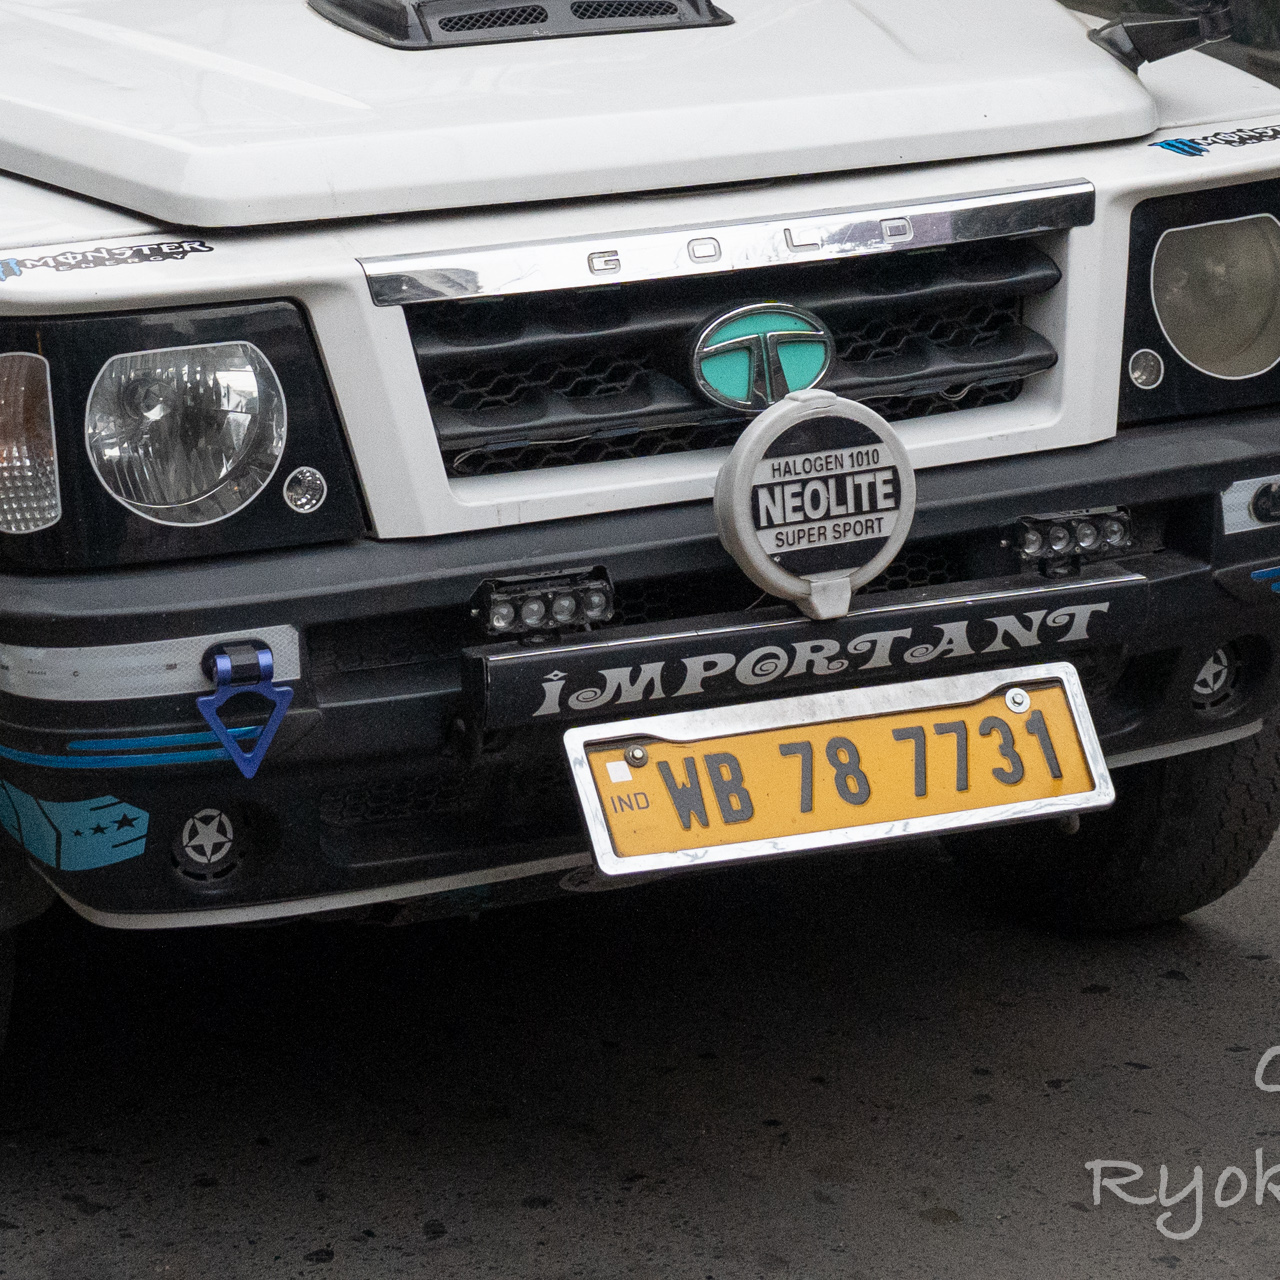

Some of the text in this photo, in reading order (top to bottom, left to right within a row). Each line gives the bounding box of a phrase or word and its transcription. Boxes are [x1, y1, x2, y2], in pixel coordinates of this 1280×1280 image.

[24, 240, 211, 268] MONSTER
[586, 216, 914, 276] GOLD
[58, 253, 185, 271] ENERGY
[772, 448, 880, 479] HALOGEN 1010
[756, 469, 896, 527] NEOLITE
[775, 517, 884, 548] SUPER SPORT
[656, 709, 1064, 832] WB 78 7731
[611, 791, 651, 814] IND
